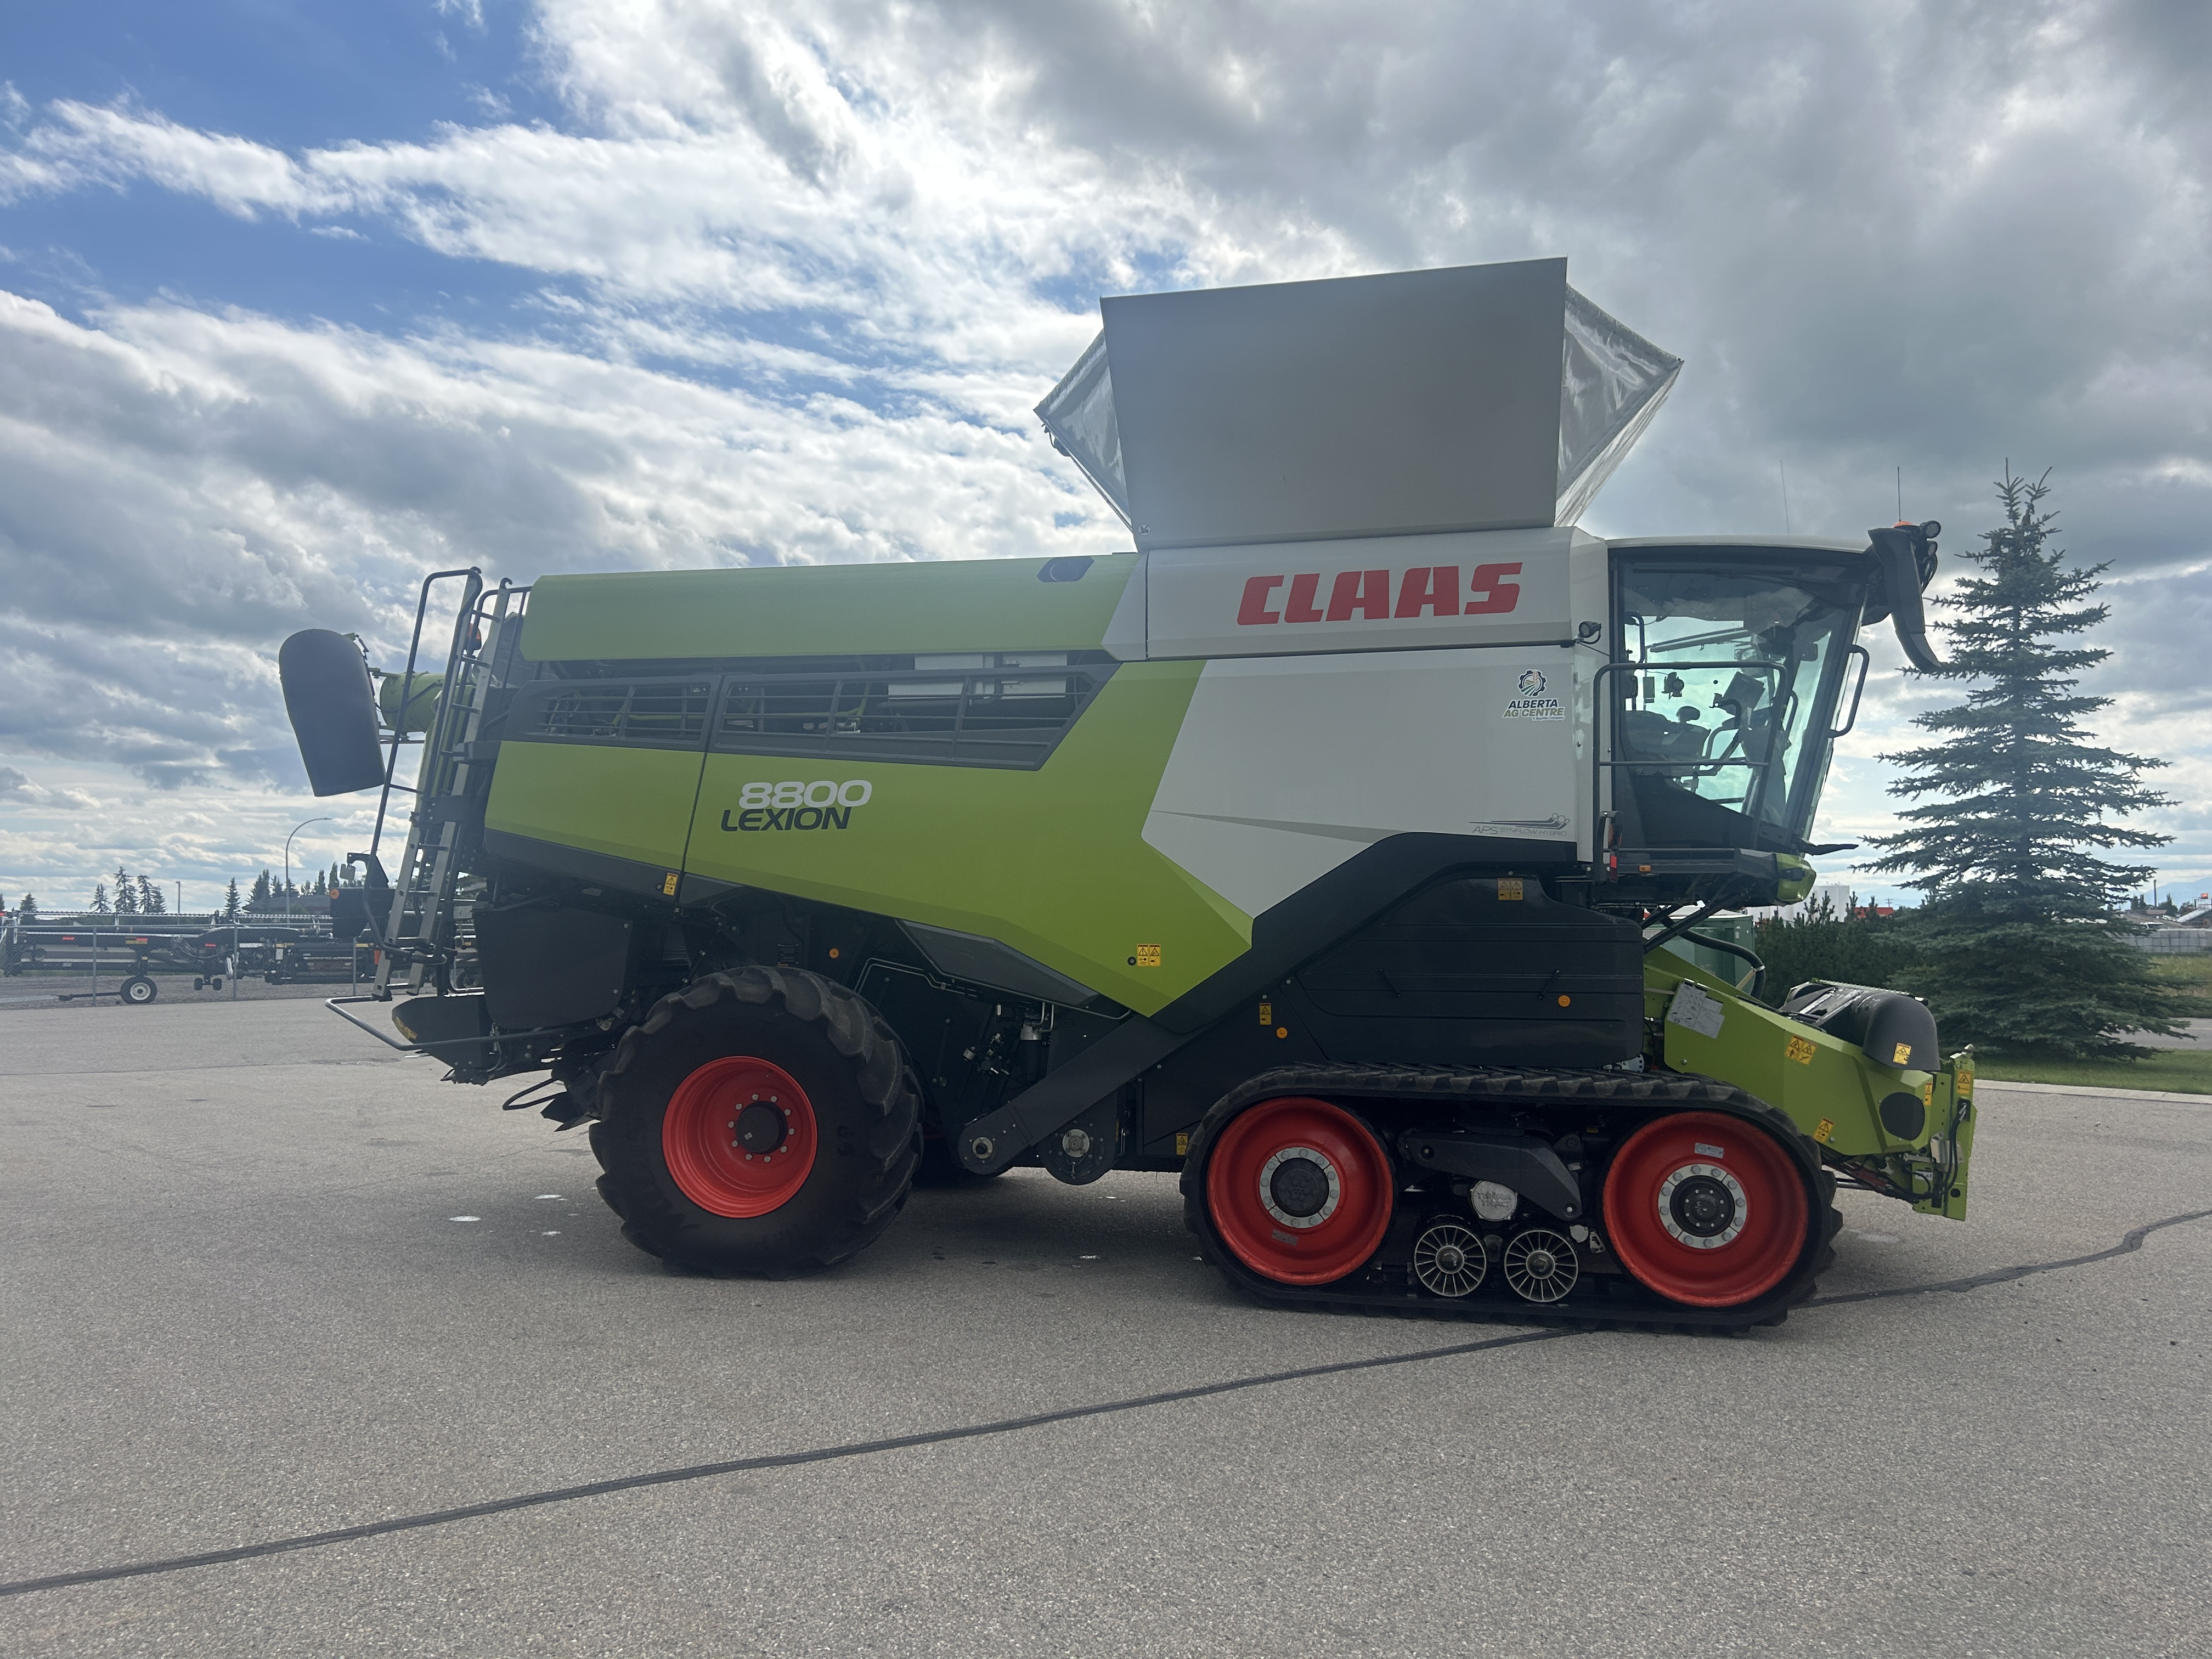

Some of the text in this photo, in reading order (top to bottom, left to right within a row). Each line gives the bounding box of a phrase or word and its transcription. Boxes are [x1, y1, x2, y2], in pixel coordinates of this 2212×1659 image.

[1237, 562, 1523, 626] CLAAS
[1503, 708, 1564, 718] AG CENTRE
[1508, 699, 1558, 709] ALBERTA
[738, 779, 872, 810] 8800
[720, 806, 852, 832] LEXION
[1472, 825, 1500, 835] APS
[1500, 827, 1537, 835] SYNFLOW
